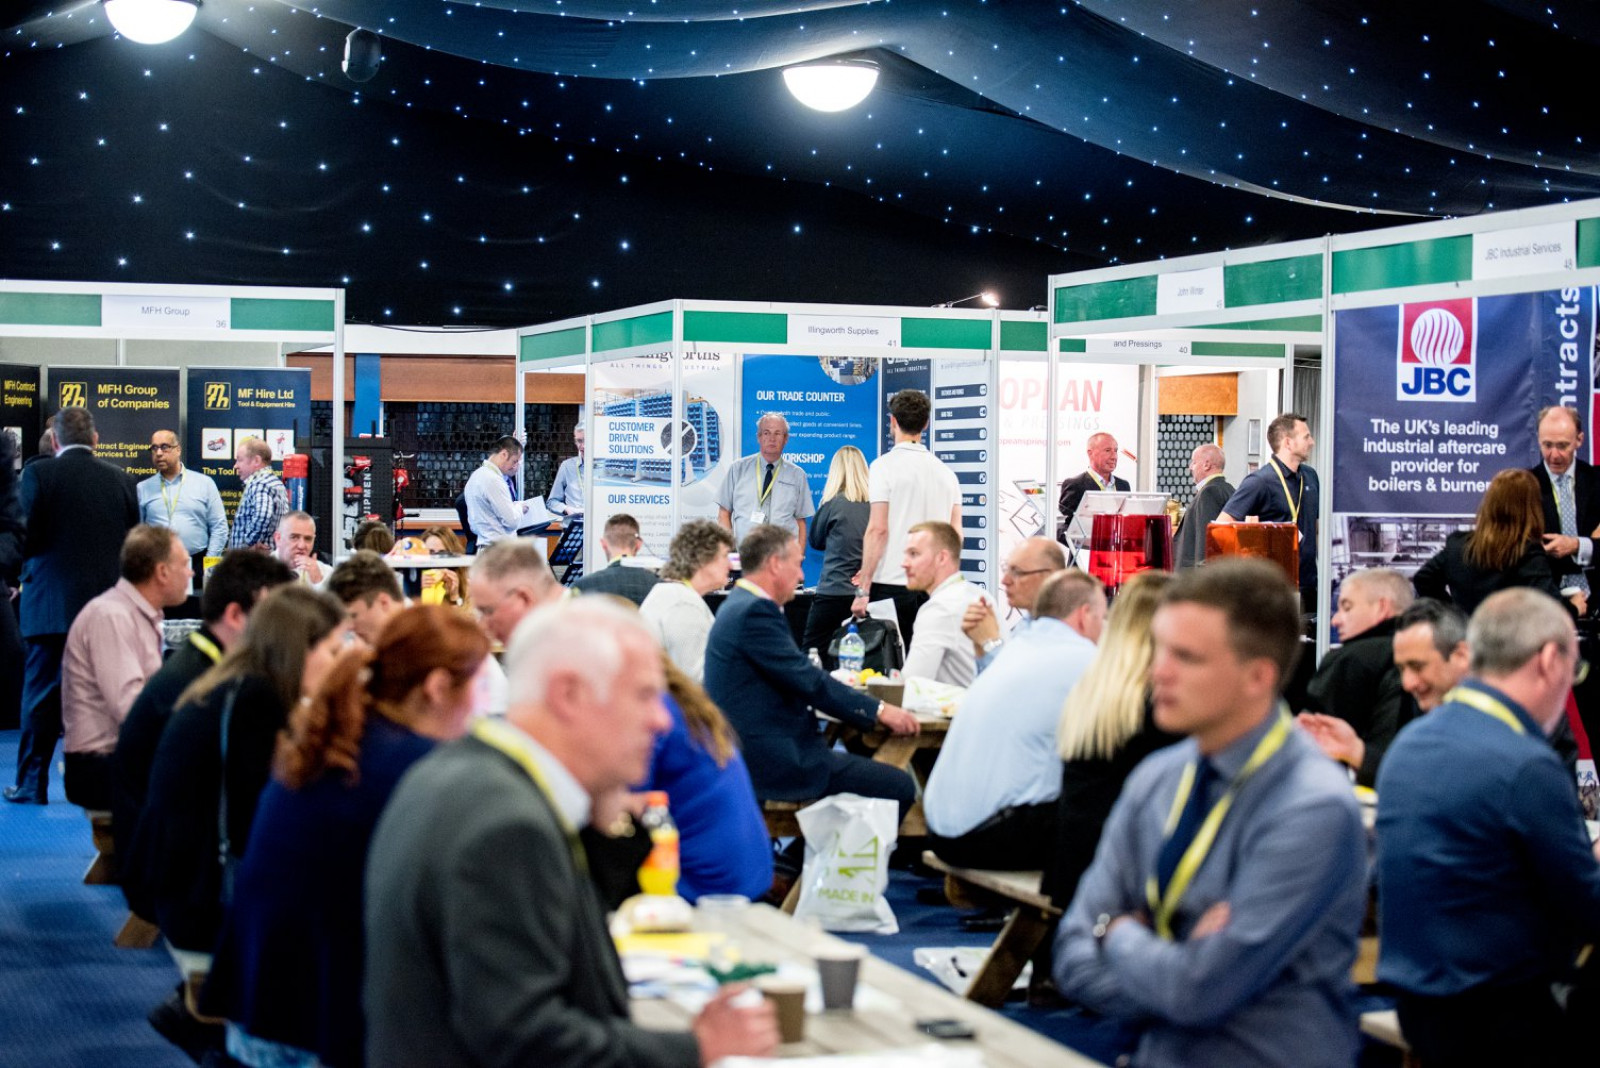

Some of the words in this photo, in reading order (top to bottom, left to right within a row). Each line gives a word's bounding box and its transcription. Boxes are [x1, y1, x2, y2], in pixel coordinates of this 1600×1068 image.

[1500, 245, 1530, 258] Industrial
[1532, 243, 1562, 254] Services
[141, 306, 162, 315] MFH
[164, 306, 190, 316] Group
[216, 320, 226, 328] 36
[808, 326, 846, 336] Illingworth
[847, 327, 879, 336] Supplies
[1128, 340, 1162, 350] Pressings
[4, 380, 16, 390] MFH
[1401, 367, 1471, 396] JBC
[98, 384, 122, 394] MFH
[124, 384, 158, 397] Group
[238, 388, 254, 398] MF
[256, 389, 276, 399] Hire
[278, 390, 294, 399] Ltd
[756, 390, 775, 400] OUR
[776, 391, 804, 402] TRADE
[806, 392, 846, 402] COUNTER
[98, 398, 108, 408] of
[110, 399, 170, 410] Companies
[609, 422, 654, 432] CUSTOMER
[1020, 416, 1100, 430] PRESINGS
[1370, 418, 1400, 434] The
[1444, 420, 1499, 438] leading
[608, 434, 639, 442] DRIVEN
[608, 444, 654, 454] SOLUTIONS
[1364, 438, 1434, 453] industrial
[1438, 438, 1506, 454] aftercare
[202, 467, 216, 475] The
[218, 467, 234, 476] Tool
[1391, 458, 1452, 474] provider
[1456, 458, 1480, 473] for
[1368, 477, 1422, 492] boilers
[1426, 478, 1438, 492] &
[1441, 478, 1490, 492] burner
[608, 494, 627, 504] OUR
[629, 494, 670, 504] SERVICES
[818, 888, 858, 902] MADE
[861, 892, 875, 902] IN
